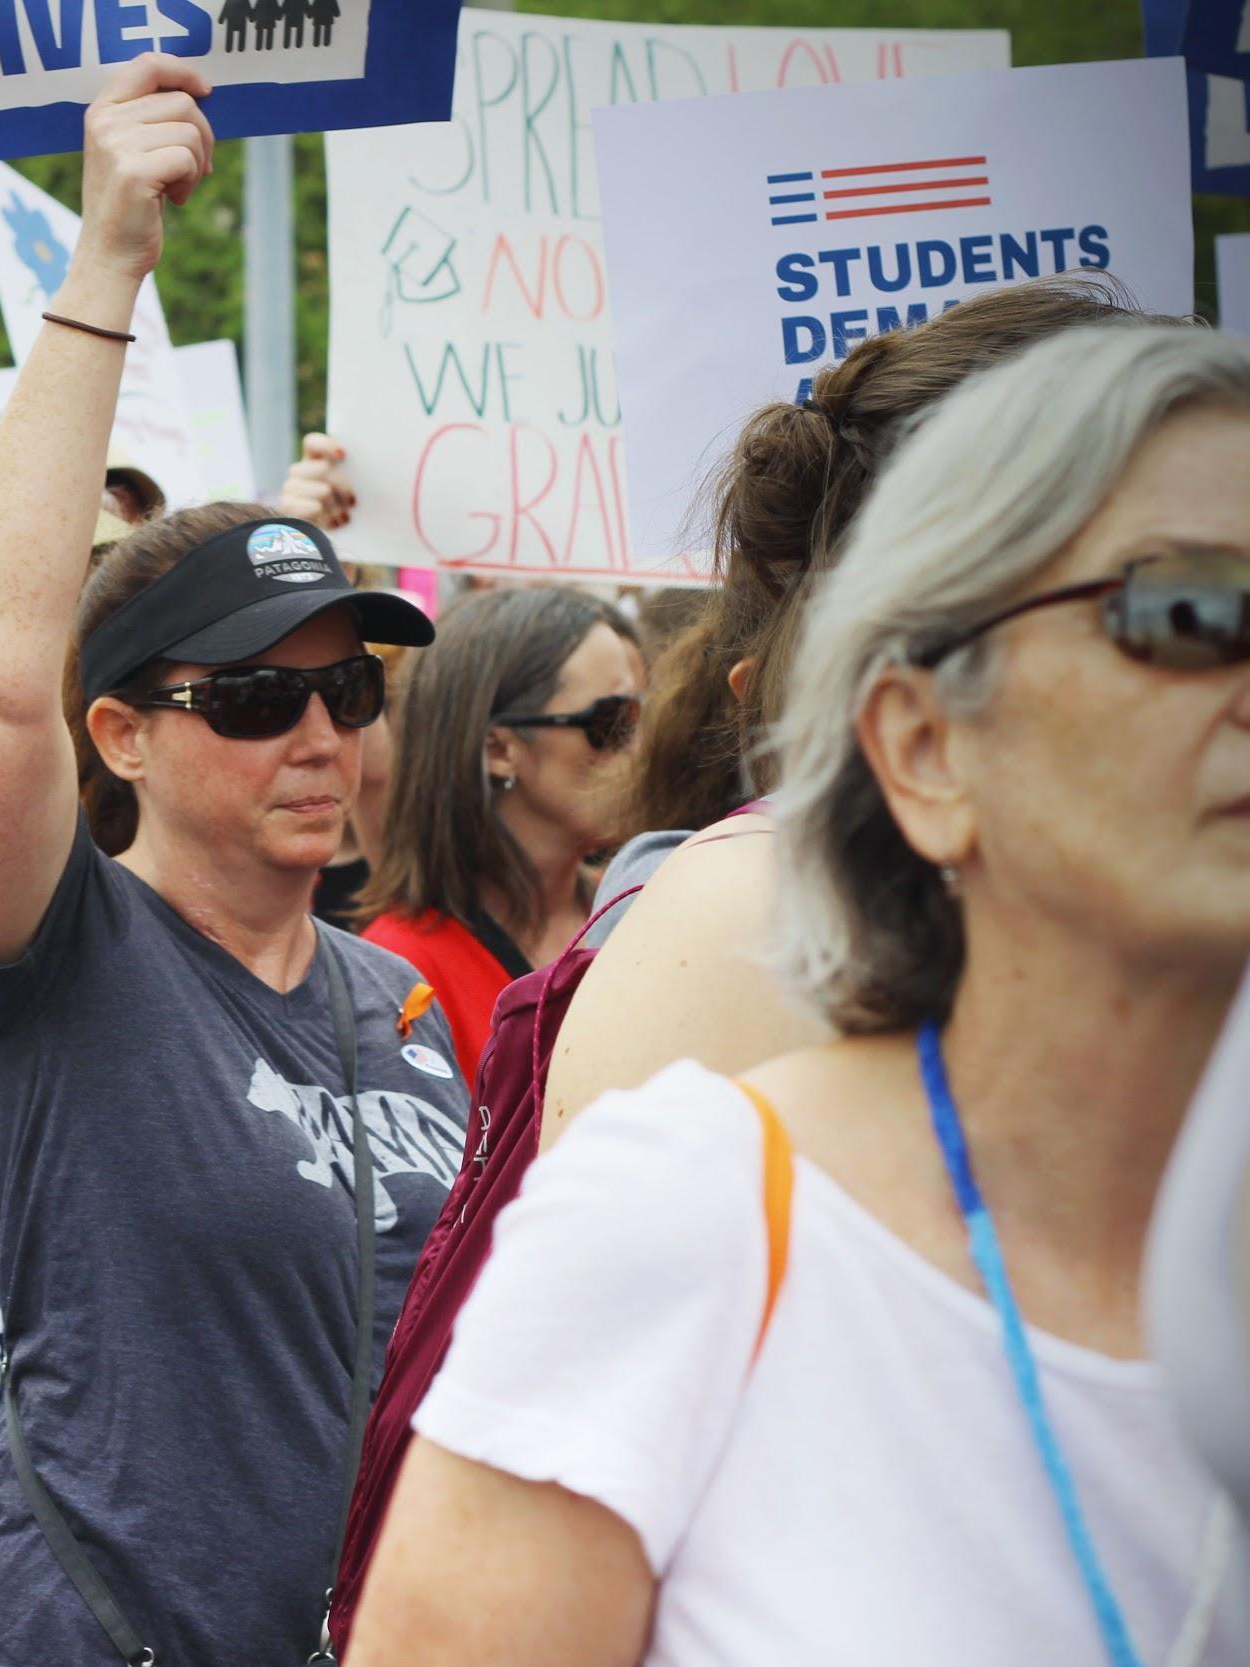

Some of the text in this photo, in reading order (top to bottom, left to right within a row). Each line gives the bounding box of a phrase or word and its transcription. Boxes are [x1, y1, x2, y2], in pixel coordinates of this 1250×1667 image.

[775, 224, 1111, 302] STUDENTS
[402, 342, 524, 424] WE
[254, 560, 333, 578] PATAGONIA
